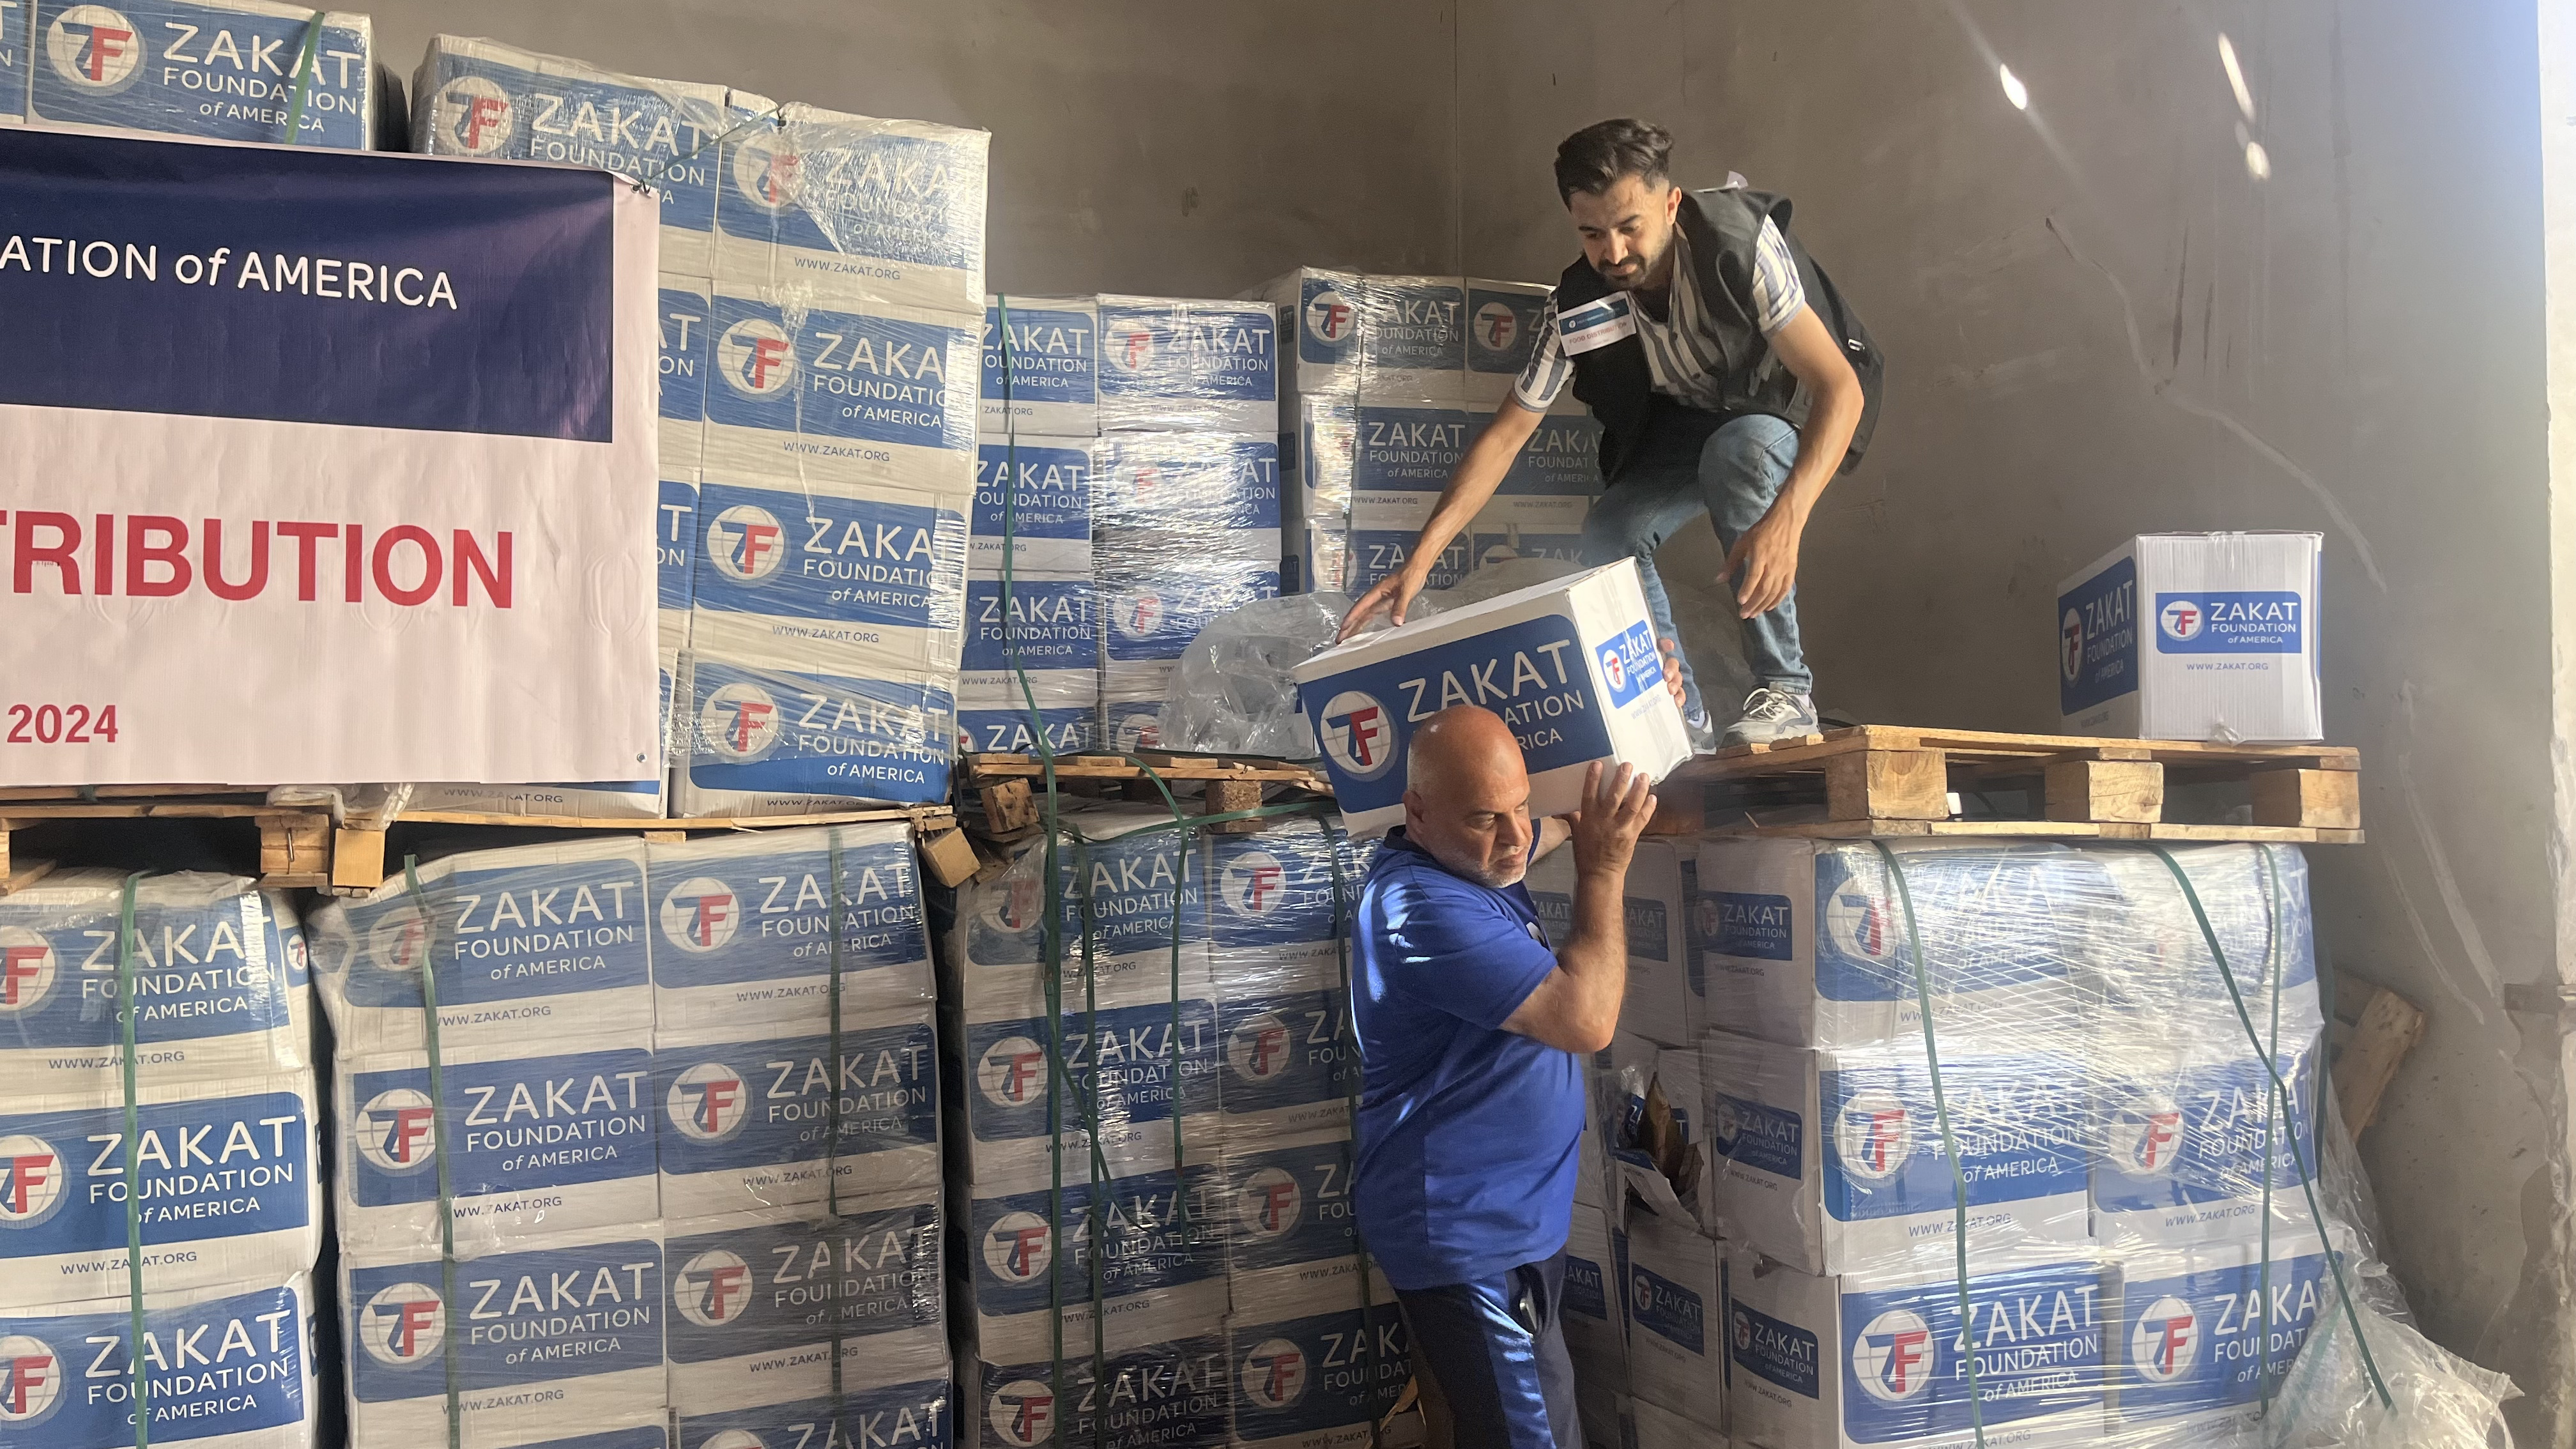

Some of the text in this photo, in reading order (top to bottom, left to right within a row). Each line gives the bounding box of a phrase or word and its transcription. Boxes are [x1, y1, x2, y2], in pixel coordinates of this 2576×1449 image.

[163, 67, 356, 116] FOUNDAION
[199, 100, 325, 133] of AMERCA
[531, 93, 702, 160] ZAKAT
[530, 139, 705, 187] FOUNDATION
[175, 247, 231, 286] of
[238, 252, 458, 310] AMERICA
[794, 257, 901, 281] WWW.ZAKAT.ORG
[1382, 300, 1461, 326] AKAT
[982, 323, 1089, 355] ZAKAT
[1167, 325, 1271, 355] ZAKAT
[1376, 328, 1459, 342] OUNDATION
[1569, 335, 1586, 344] FOOD
[984, 354, 1087, 372] OUNDATION
[1381, 345, 1443, 356] of AMERICA
[1011, 374, 1069, 388] AMERICA
[842, 405, 942, 429] of AMERICA
[1368, 423, 1466, 448] ZAKAT
[783, 441, 890, 463] WWW.ZAKAT.ORG
[1369, 451, 1463, 465] FOUNDATION
[974, 460, 1085, 492] ZAKAT
[1387, 468, 1449, 479] of AMERICA
[974, 491, 1082, 509] OUNDATION
[990, 511, 1005, 521] of
[0, 509, 512, 609] RIBUTION
[1368, 544, 1464, 571] ZAAT
[831, 587, 931, 609] of AMERICA
[979, 596, 1094, 624] ZAKAT
[2085, 579, 2133, 640] ZAKAT
[2210, 602, 2298, 621] ZAKAT
[772, 624, 880, 644] WWW.ZAKAT.ORG
[980, 626, 1091, 641] FOUNDATION
[2211, 623, 2296, 633] FOUNDATION
[2227, 635, 2283, 644] of AMERICA
[1017, 645, 1073, 656] AMERICA
[1618, 629, 1652, 664] ZAKAT
[2087, 627, 2133, 665] FOUNDATION
[2186, 663, 2269, 671] WWW.ZAKAT.ORG
[1398, 639, 1571, 723] ZAKAT
[6, 703, 119, 744] 2024
[798, 692, 949, 743] ZAKAT
[798, 734, 945, 766] FOUNDATION
[827, 763, 925, 784] of AMERICA
[1061, 848, 1197, 900] ZAKAT
[454, 881, 635, 935] ZAKAT
[761, 903, 916, 938] FOUNATION
[1724, 904, 1788, 926] ZAKAT
[455, 925, 633, 961] FOUNDATION
[1725, 925, 1787, 939] FOUNDATION
[793, 943, 812, 958] of
[490, 955, 606, 981] of AMERICA
[736, 982, 847, 1002] WWW.ZAKAT.OG
[144, 995, 249, 1022] AMERICA
[438, 1006, 551, 1027] WW.ZAKAT.ORG
[1065, 1018, 1209, 1069] ZAKAT
[766, 1045, 928, 1100] ZAKAT
[463, 1071, 648, 1126] ZAKAT
[466, 1114, 645, 1152] FOUNDATION
[800, 1127, 818, 1142] of
[1741, 1110, 1799, 1143] ZAKAT
[86, 1116, 297, 1177] ZAKAT
[1741, 1133, 1797, 1156] FOUNDATION
[502, 1146, 618, 1171] of AMERICA
[1963, 1156, 2060, 1183] of AMERICA
[157, 1197, 261, 1223] AMERICA
[2165, 1204, 2255, 1227] WWW.ZAKAT.ORG
[60, 1251, 197, 1275] WWW.ZAAT.ORG
[469, 1261, 654, 1320] ZAKAT
[1655, 1284, 1701, 1321] ZAKAT
[471, 1306, 650, 1345] FOUNDATION
[806, 1310, 824, 1325] of
[85, 1309, 291, 1379] ZAKAT
[505, 1337, 622, 1365] of AMERICA
[1754, 1322, 1815, 1361] ZAKAT
[749, 1346, 859, 1373] WWW.ZAKAT.RG
[1755, 1344, 1814, 1376] FOUNDATION
[1077, 1353, 1220, 1413] ZAKAT
[2237, 1365, 2255, 1383] of
[1984, 1383, 2004, 1402] of
[155, 1394, 257, 1422] AMERICA
